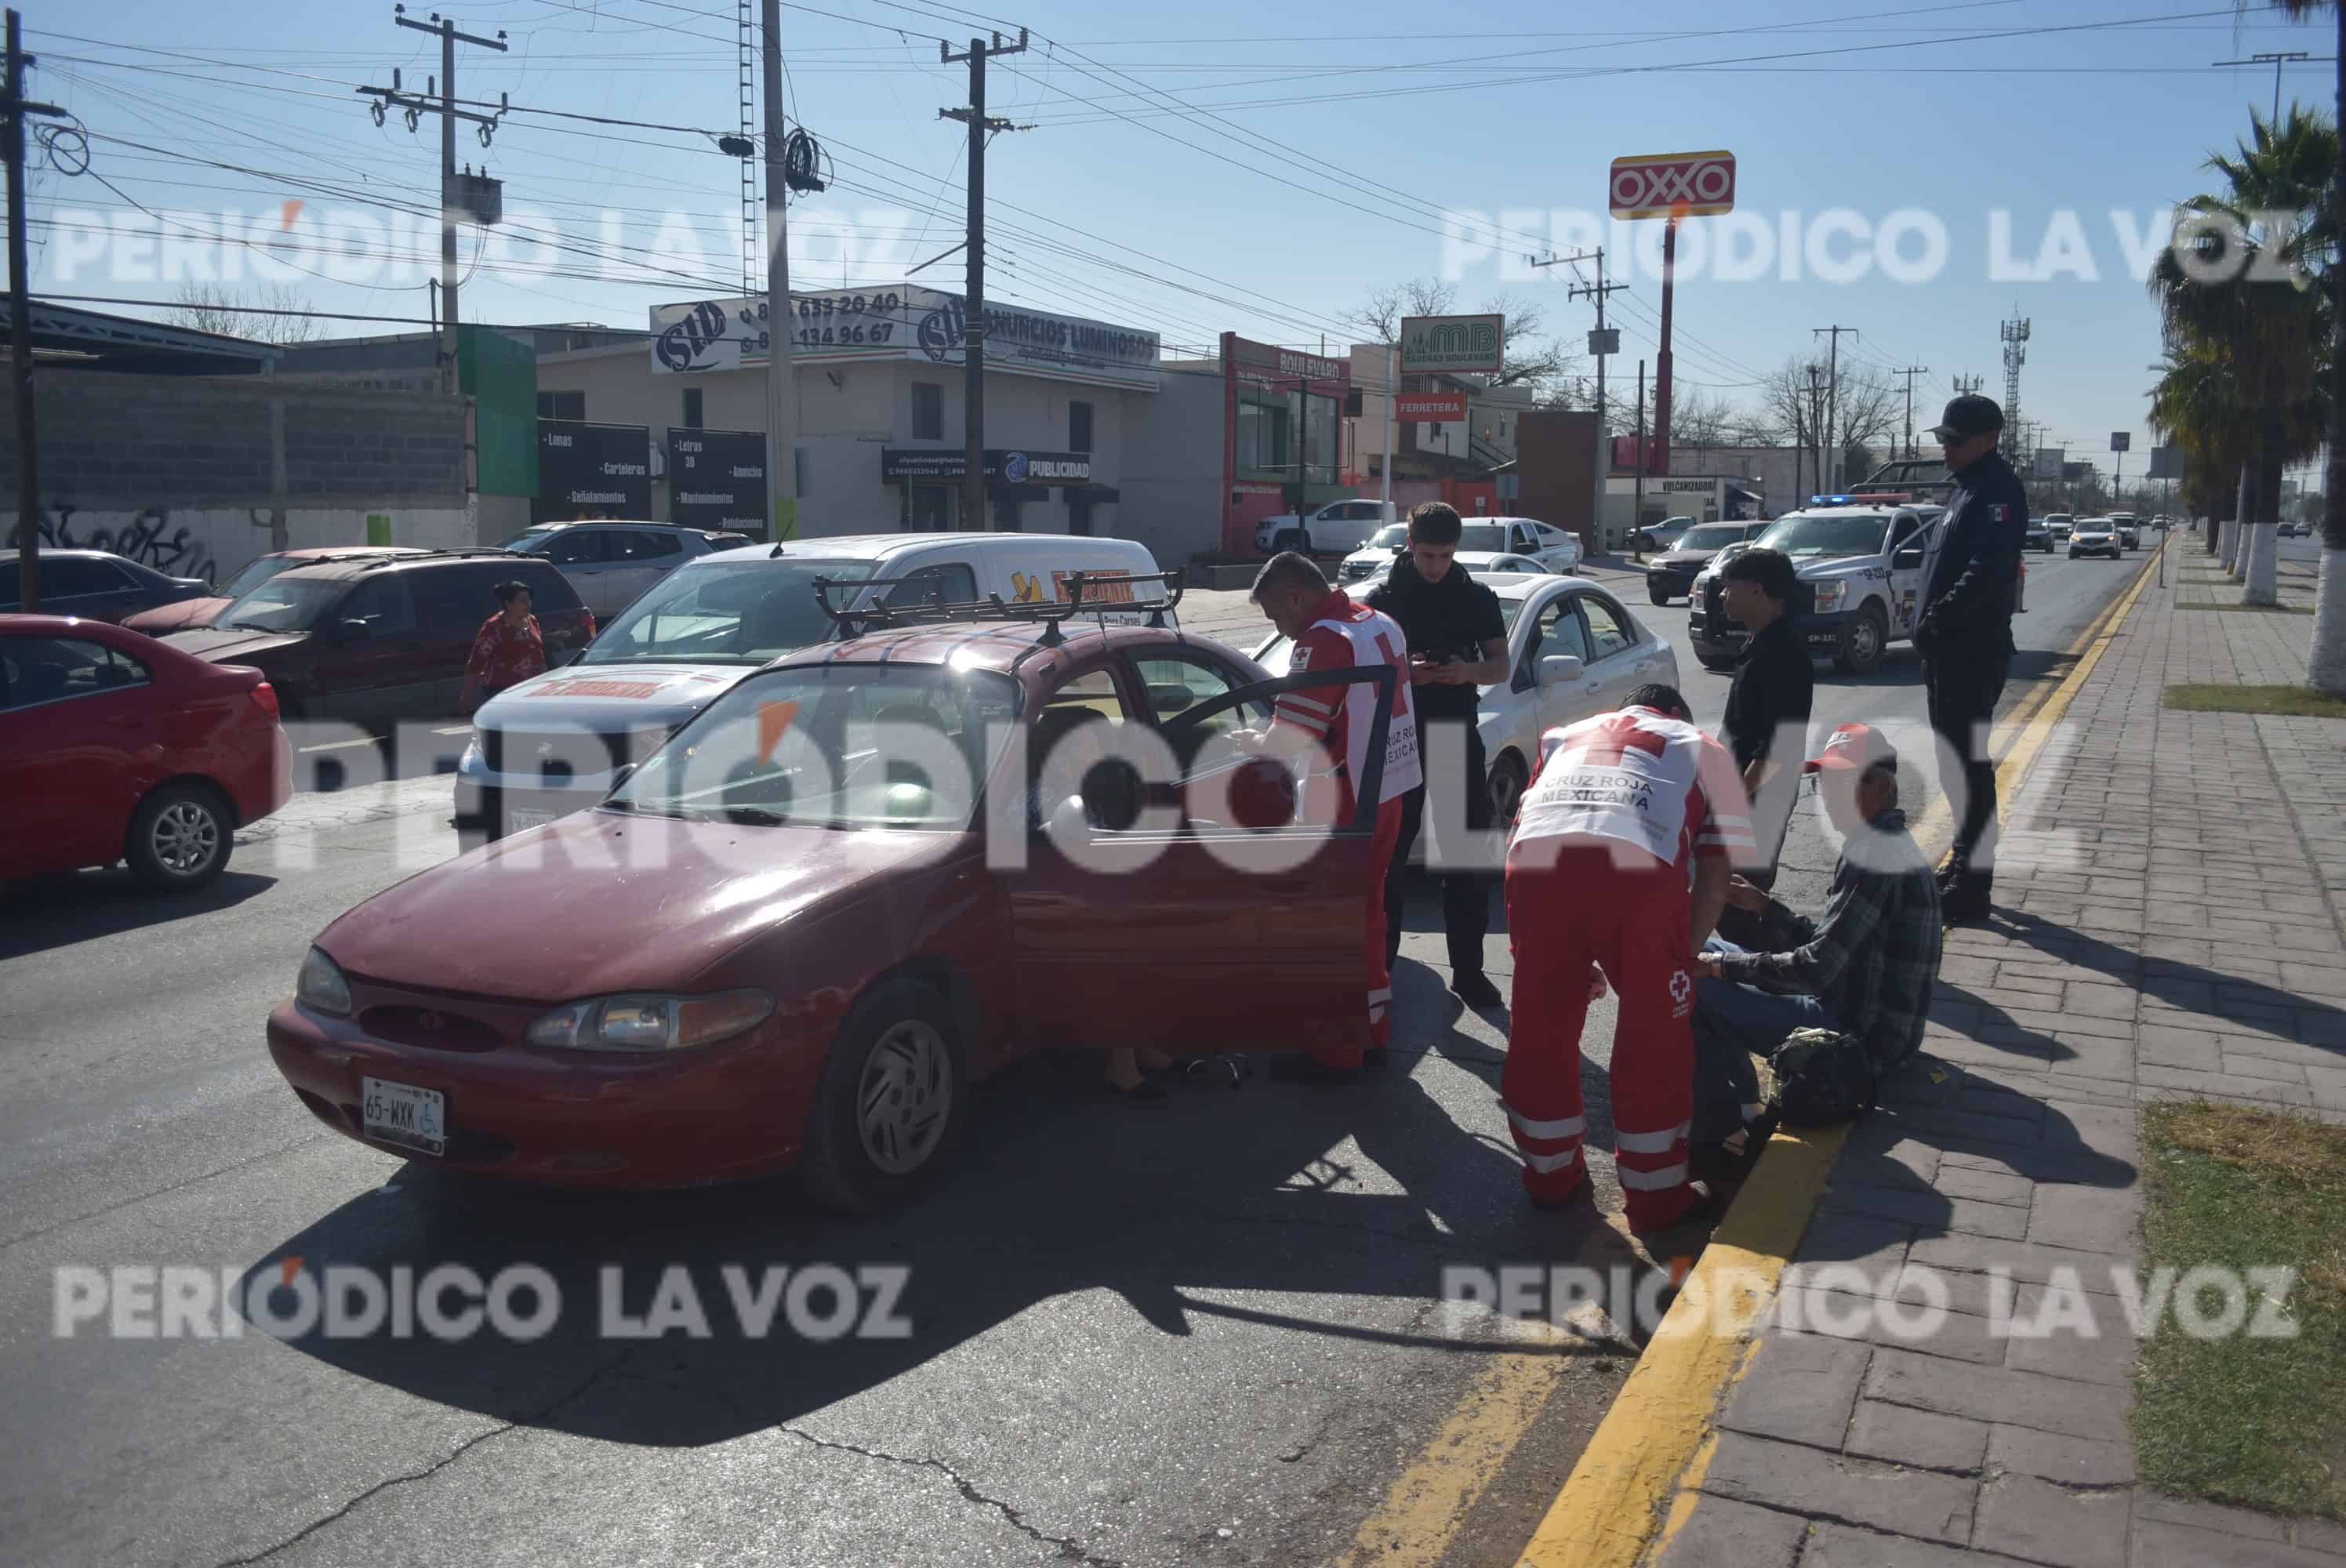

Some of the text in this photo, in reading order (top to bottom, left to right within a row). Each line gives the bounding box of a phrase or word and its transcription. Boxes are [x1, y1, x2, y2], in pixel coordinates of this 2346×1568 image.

[1612, 160, 1730, 209] OXXO
[840, 295, 865, 315] 20
[870, 292, 899, 312] 40
[799, 322, 894, 345] 134 96 67
[1070, 323, 1155, 360] LUMINOSOS
[1279, 353, 1339, 378] BOULEVARD
[1404, 352, 1496, 363] MADERAS BOULEVARD
[1400, 403, 1459, 413] FERRETERA
[548, 434, 572, 447] Lonas
[679, 439, 703, 452] Letras
[605, 463, 645, 475] Carteleras
[1030, 460, 1089, 477] PUBLICIDAD
[572, 491, 626, 504] Señalamientos
[680, 492, 734, 504] Mantenimientos
[1387, 729, 1401, 747] RUZ
[1545, 775, 1653, 795] CRUZ ROJA
[1542, 789, 1649, 811] MEXICANA
